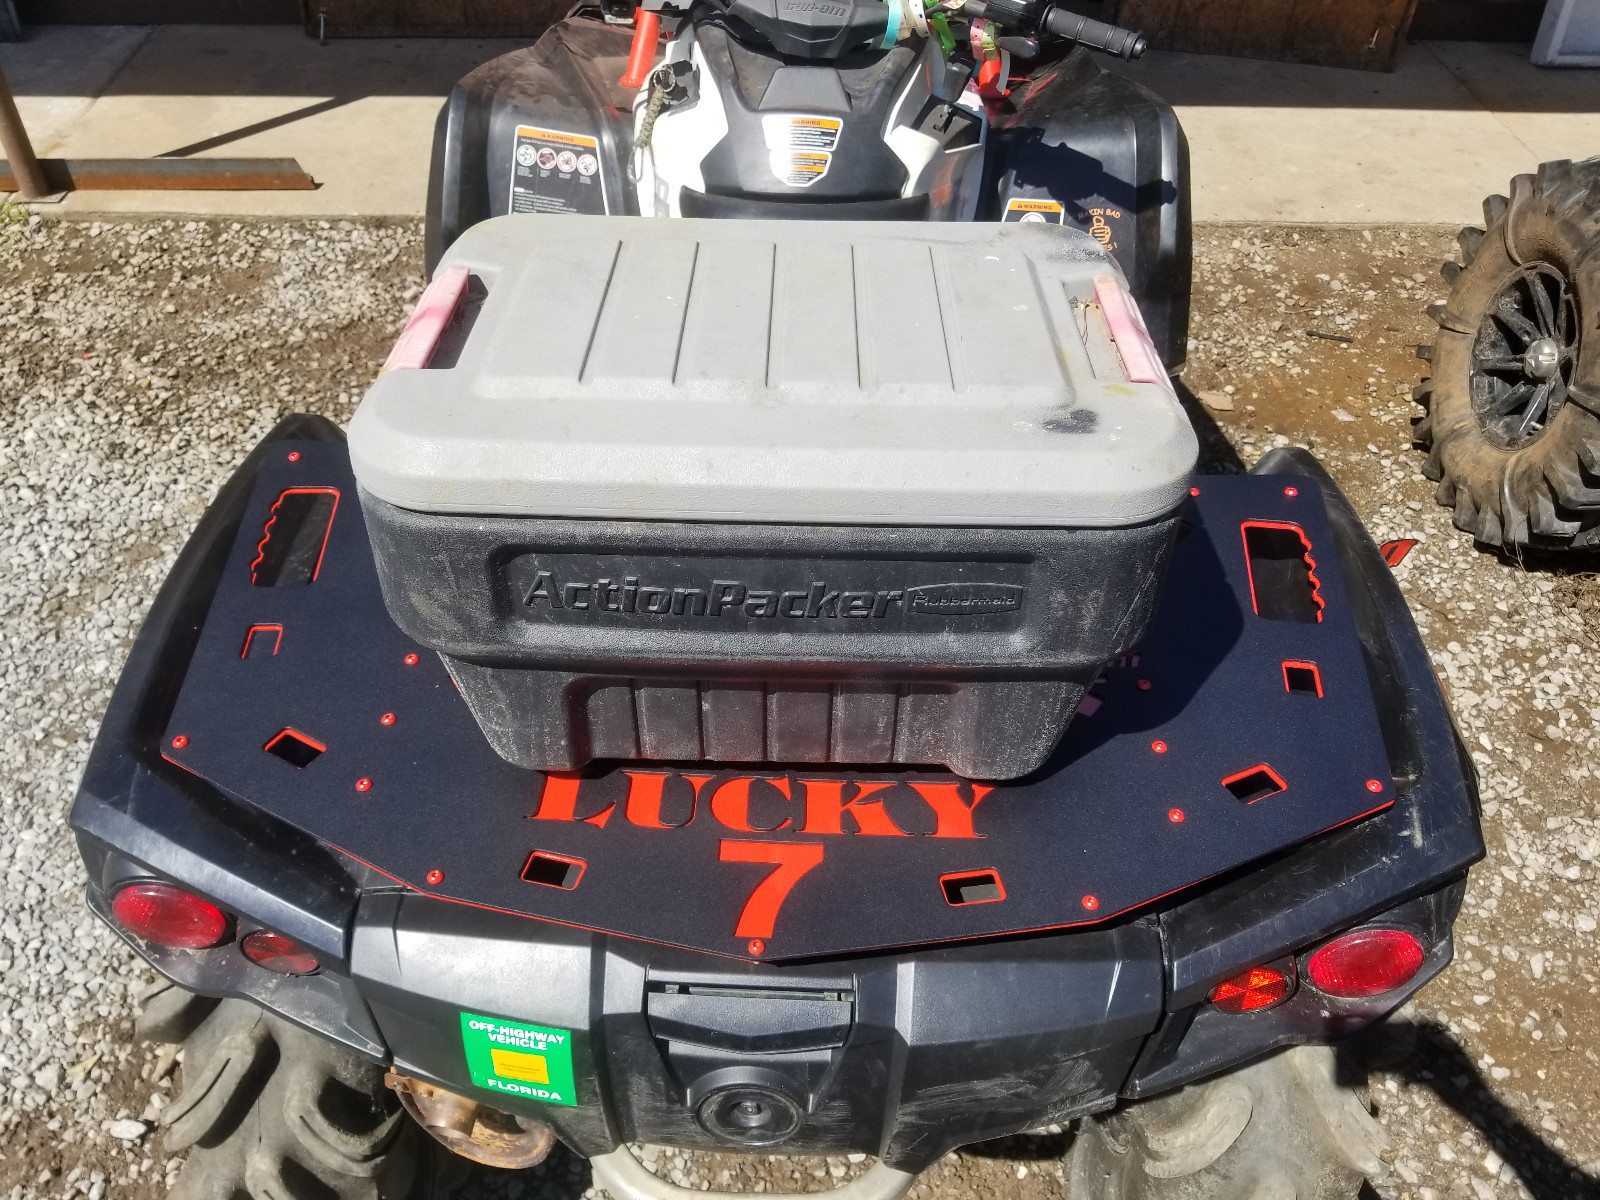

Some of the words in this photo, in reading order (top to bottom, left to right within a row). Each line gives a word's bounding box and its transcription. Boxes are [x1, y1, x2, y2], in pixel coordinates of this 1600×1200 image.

[1105, 208, 1121, 219] BAD
[522, 570, 903, 619] ActionPacker
[911, 593, 1016, 606] Rubbermaid
[523, 769, 995, 839] LUCKY
[719, 838, 824, 939] 7
[468, 1020, 565, 1044] OFF-HIGHWAY
[487, 1033, 547, 1050] VEHICLE
[487, 1079, 562, 1101] FLORIDA
